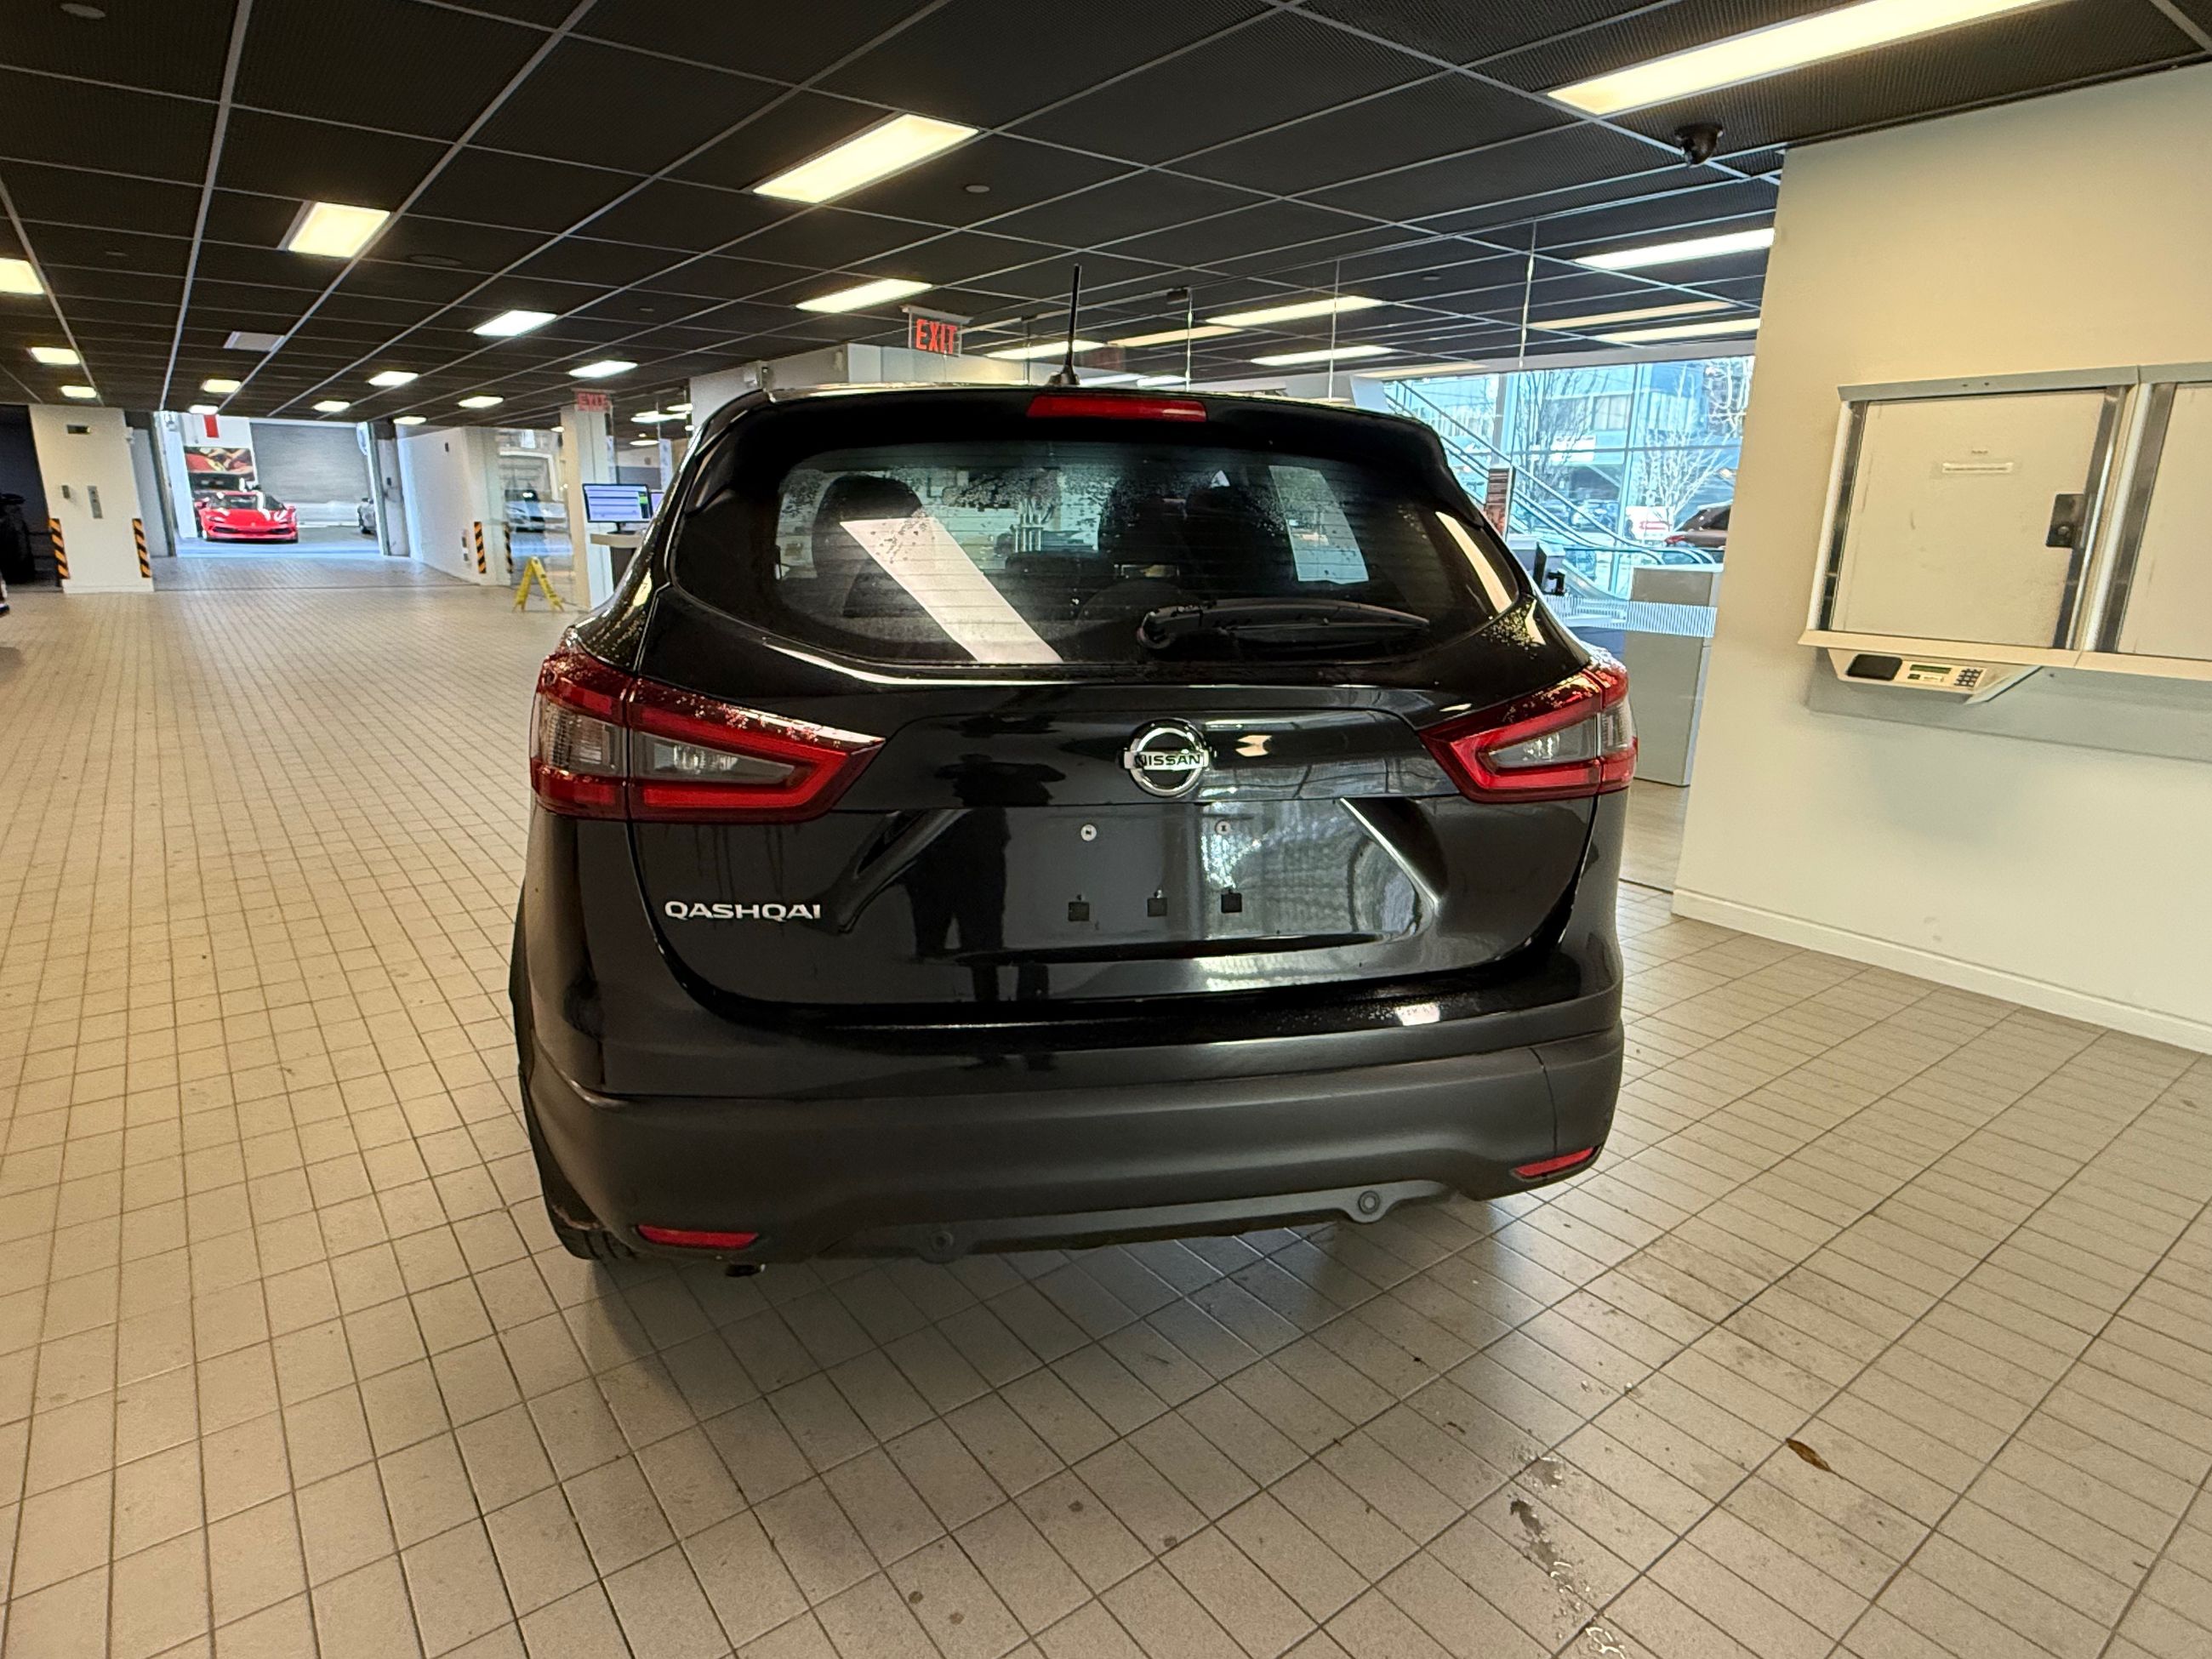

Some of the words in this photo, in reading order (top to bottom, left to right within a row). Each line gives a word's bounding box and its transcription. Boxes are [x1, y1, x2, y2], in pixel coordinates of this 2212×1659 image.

[915, 318, 957, 355] EXIT
[1134, 754, 1200, 767] NISSAN
[664, 901, 821, 922] QASHQAI
